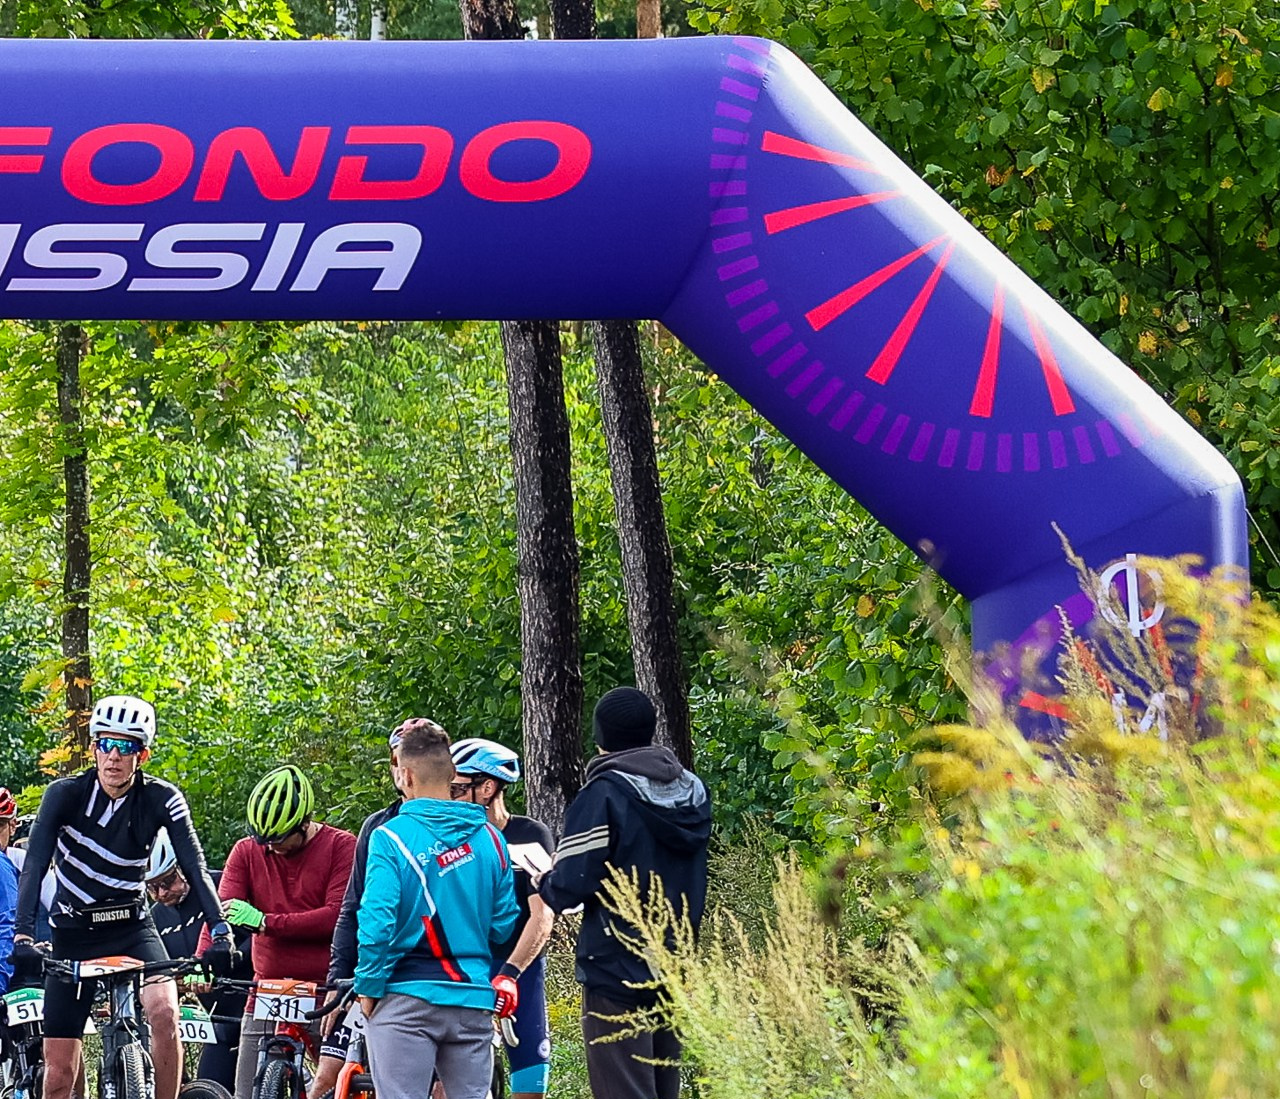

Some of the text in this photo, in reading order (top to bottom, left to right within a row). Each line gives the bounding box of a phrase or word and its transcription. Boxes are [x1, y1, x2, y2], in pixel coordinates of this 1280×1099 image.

[440, 844, 467, 866] TIME
[92, 909, 131, 923] IRONSTAR
[270, 998, 300, 1020] 311
